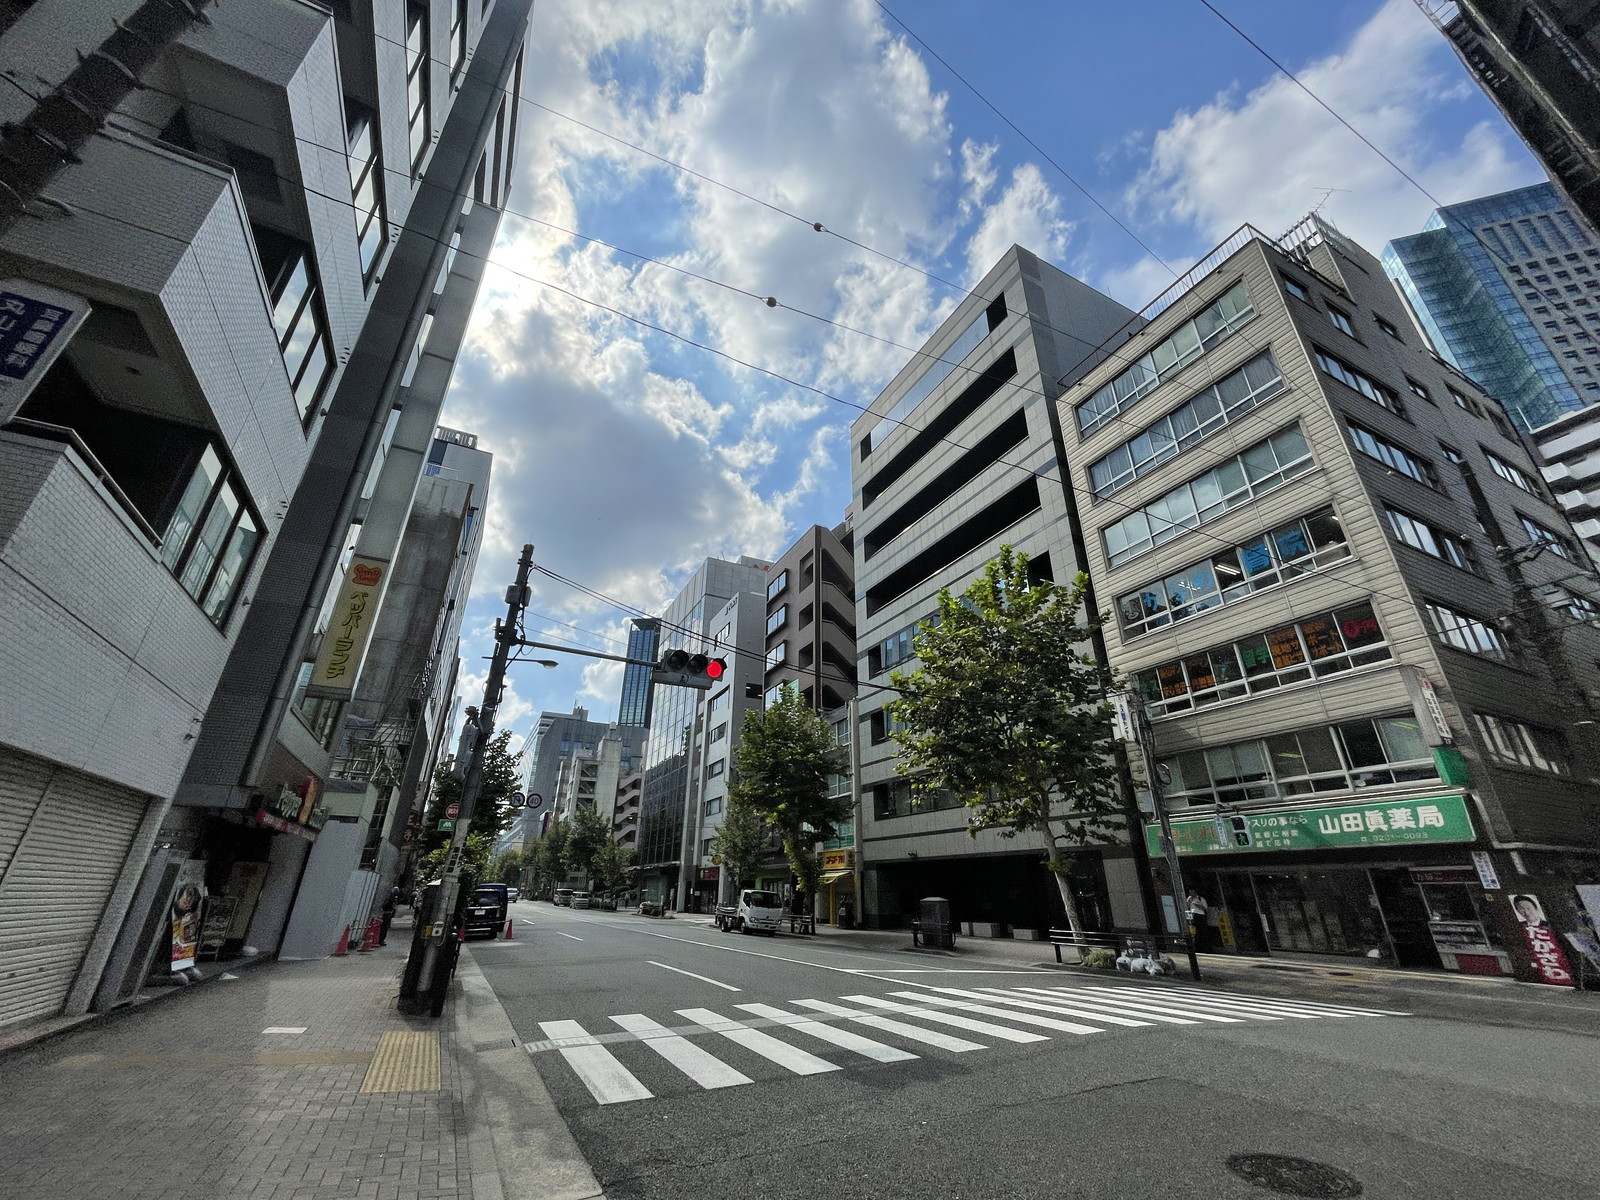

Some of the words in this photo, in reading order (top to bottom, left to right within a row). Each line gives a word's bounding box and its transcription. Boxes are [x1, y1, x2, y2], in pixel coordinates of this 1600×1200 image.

[325, 590, 370, 679] ペッパーランチ
[530, 797, 539, 805] 40
